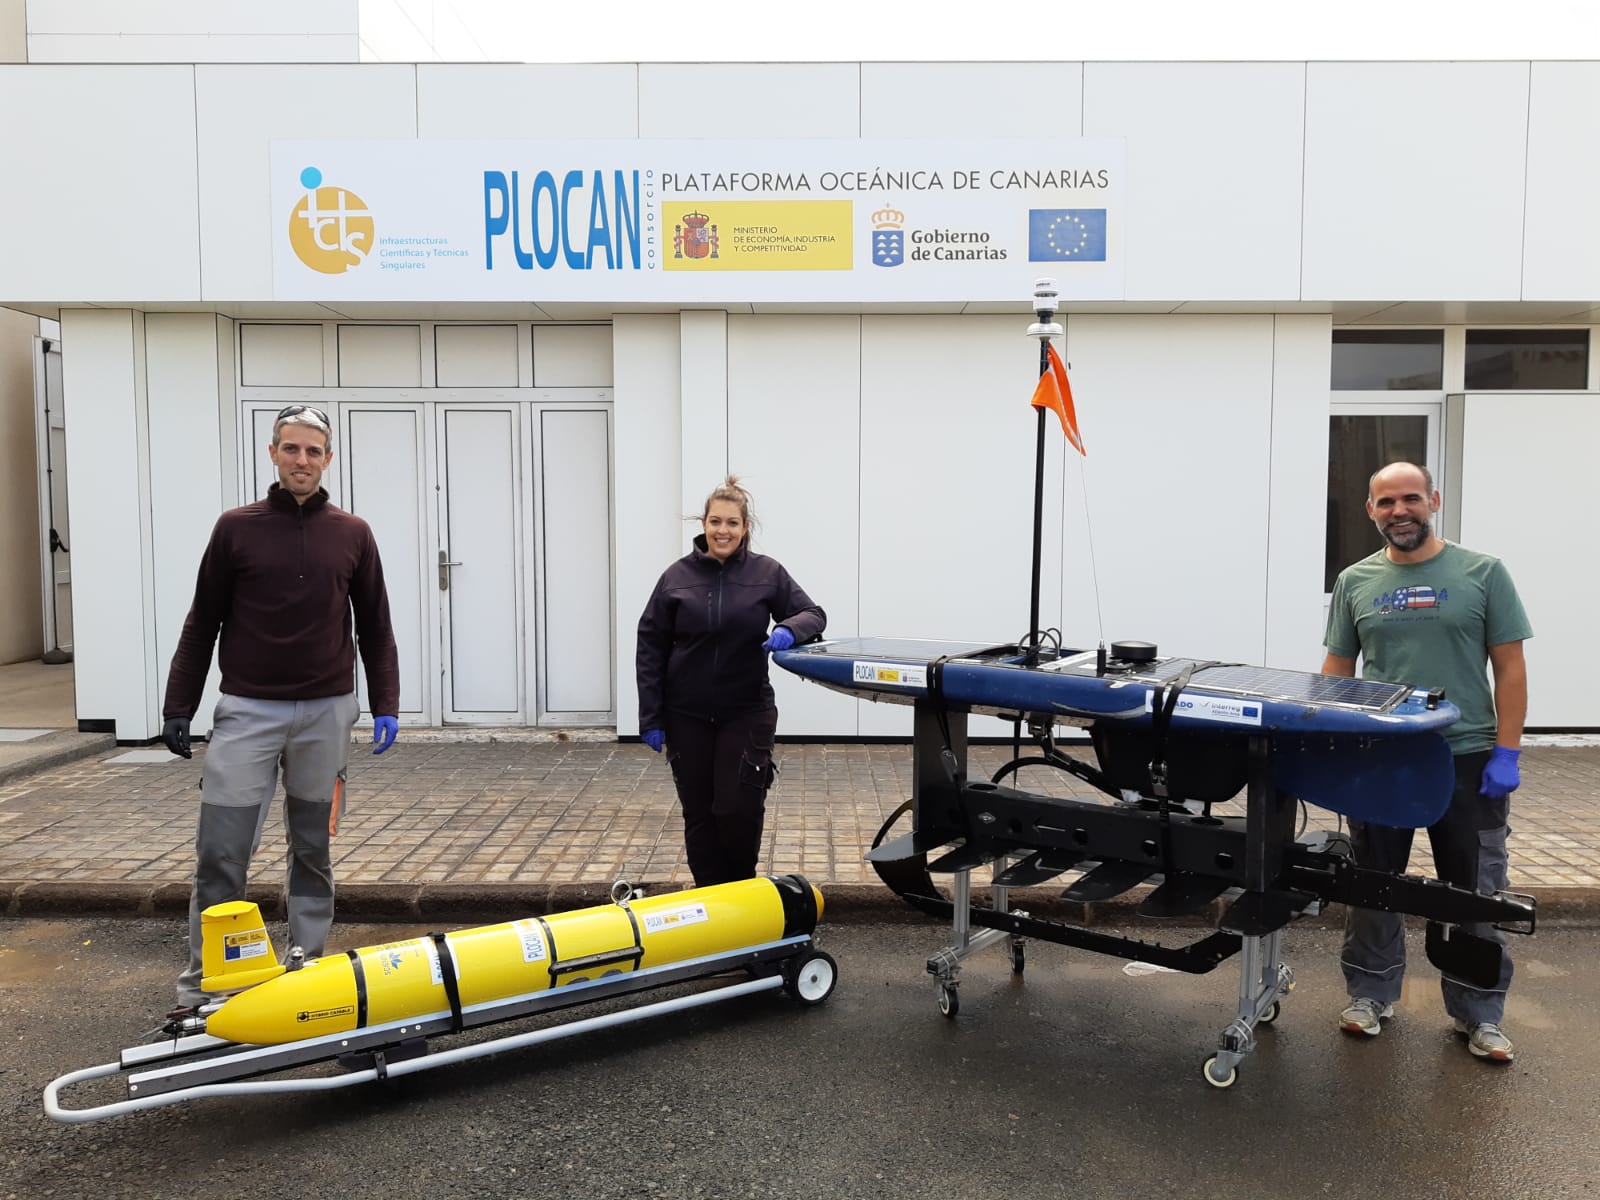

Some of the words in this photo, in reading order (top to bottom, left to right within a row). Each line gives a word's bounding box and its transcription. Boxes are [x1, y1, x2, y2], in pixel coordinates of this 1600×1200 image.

[662, 173, 811, 191] PLATAFORMA
[820, 167, 943, 191] OCEÁNICA
[954, 171, 980, 190] DE
[990, 169, 1108, 189] CANARIAS
[484, 170, 641, 271] PLOCAN
[643, 169, 655, 270] consorcio
[733, 226, 778, 234] MINISTERIO
[911, 229, 990, 244] Gobierno
[379, 237, 448, 245] Infraestructuras
[794, 235, 836, 243] INDUSTRIA
[911, 246, 931, 261] de
[934, 246, 1008, 261] Canarias
[380, 260, 426, 271] Singulares
